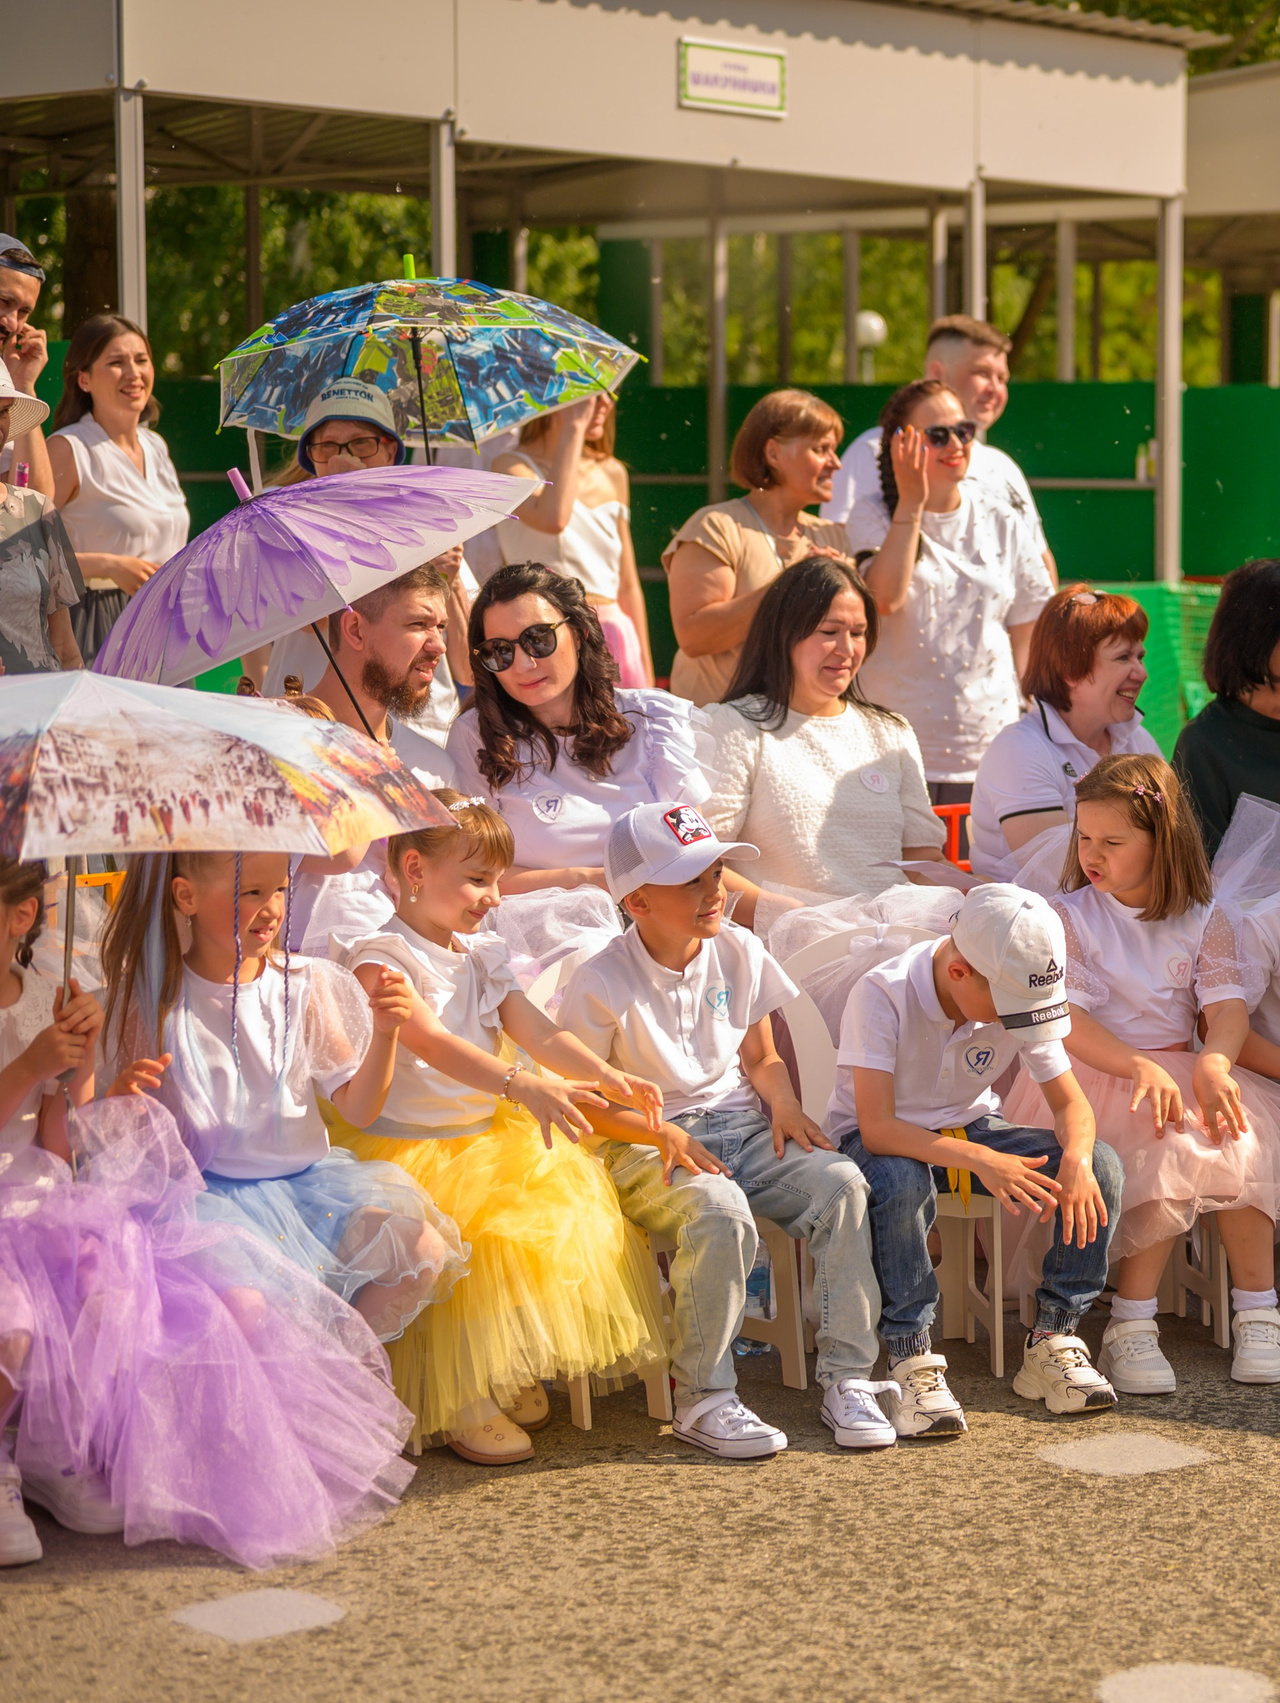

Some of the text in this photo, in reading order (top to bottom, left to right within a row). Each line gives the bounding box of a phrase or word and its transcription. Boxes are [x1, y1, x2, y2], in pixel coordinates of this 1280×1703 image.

[321, 388, 374, 402] BENETTON
[545, 798, 559, 813] Я
[1175, 961, 1188, 977] Я
[716, 990, 729, 1007] Я
[1031, 1006, 1065, 1023] Reebok
[974, 1050, 990, 1066] Я
